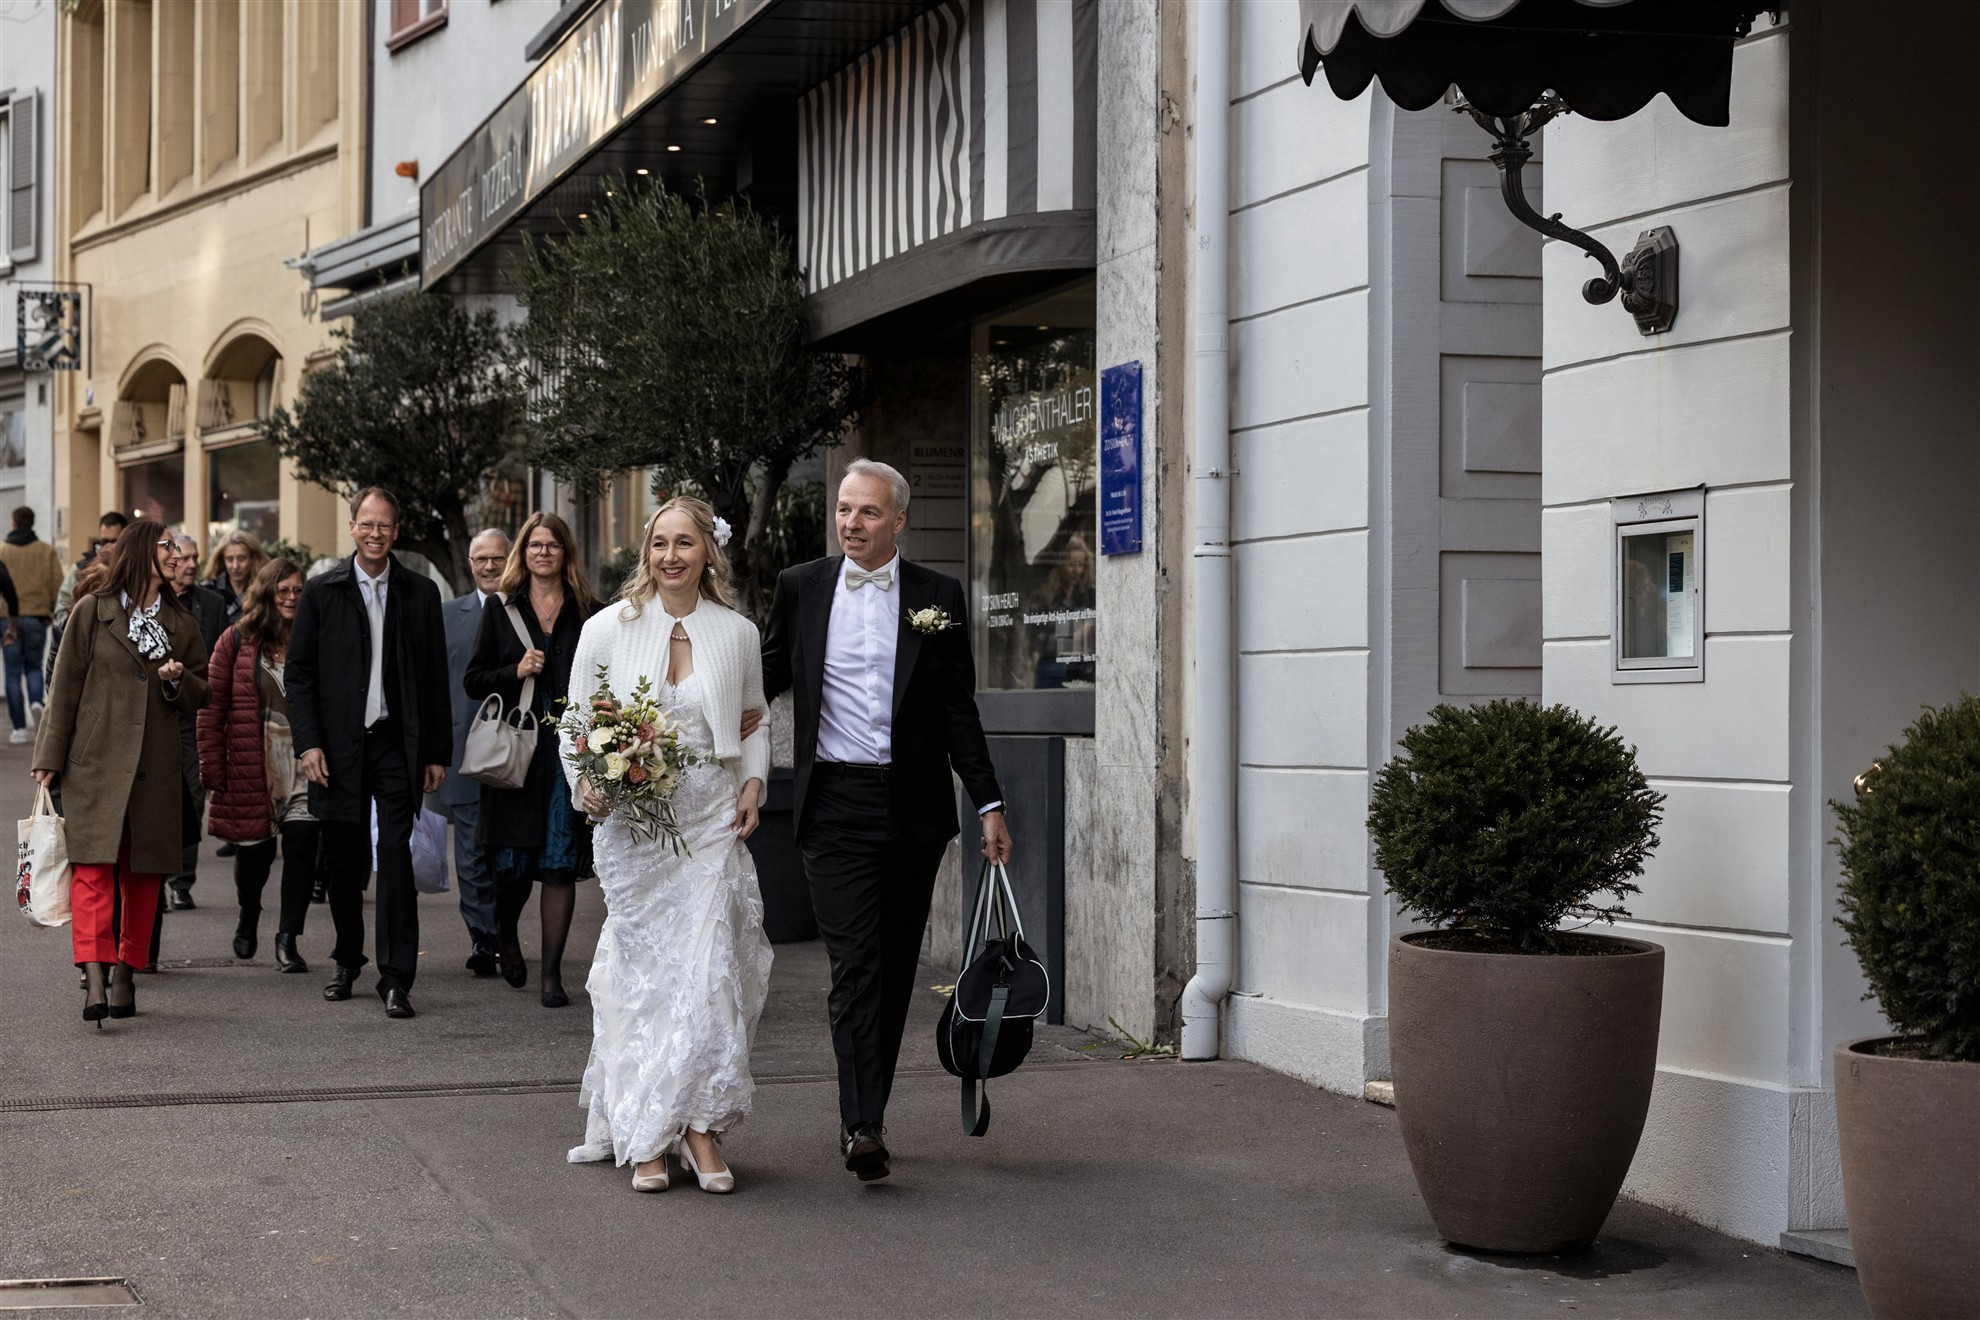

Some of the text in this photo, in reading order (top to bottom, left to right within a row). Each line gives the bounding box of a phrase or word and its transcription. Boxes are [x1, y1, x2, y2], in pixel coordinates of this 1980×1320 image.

[631, 0, 694, 88] VINERIA
[995, 387, 1092, 443] MUGGENTHALER
[913, 475, 921, 486] 2
[989, 594, 1001, 611] SKIN
[1001, 592, 1019, 609] HEALTH
